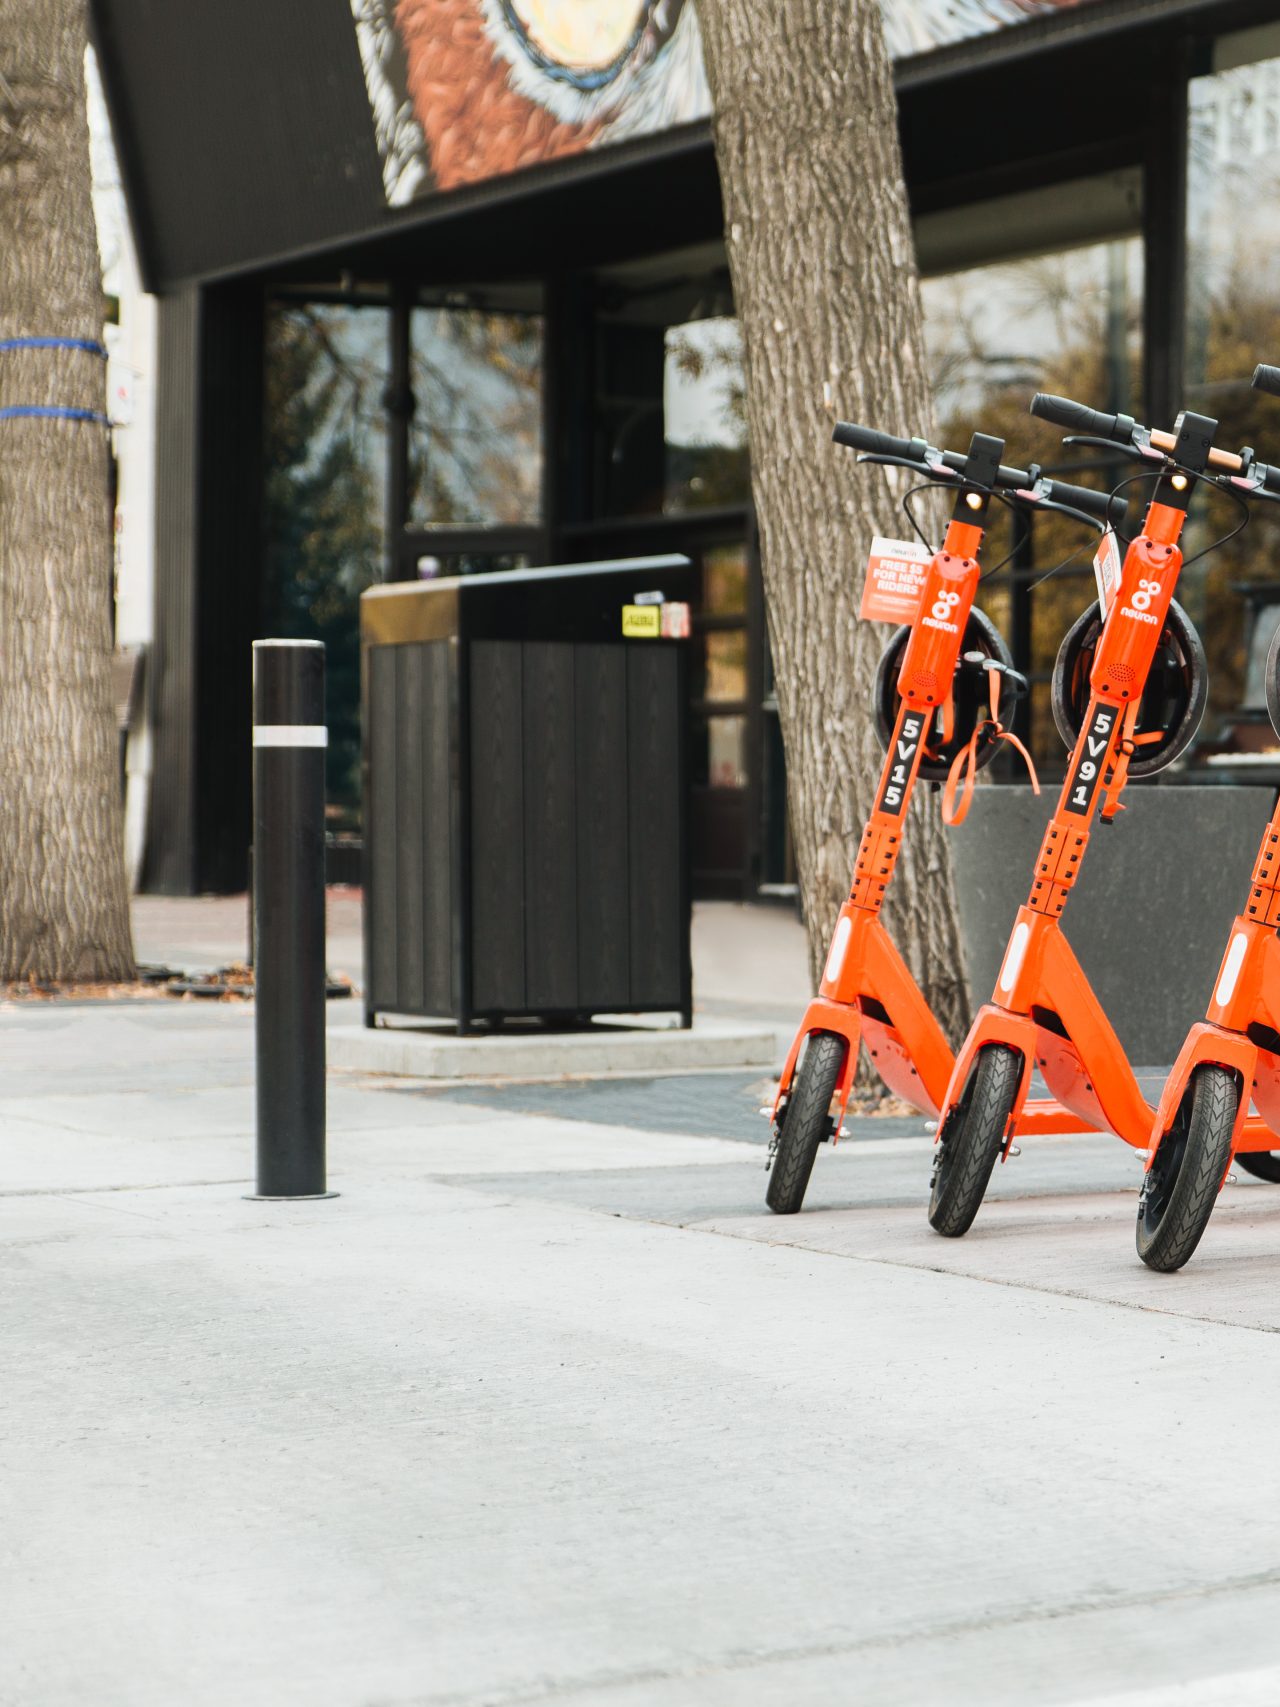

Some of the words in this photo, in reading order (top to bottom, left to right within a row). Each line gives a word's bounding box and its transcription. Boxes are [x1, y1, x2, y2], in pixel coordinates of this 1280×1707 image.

[880, 560, 909, 573] FREE
[910, 563, 924, 575] $5
[873, 569, 897, 581] FOR
[898, 573, 926, 586] NEW
[877, 580, 919, 595] RIDERS
[1120, 606, 1158, 625] neuron
[921, 616, 958, 634] neuron
[884, 718, 920, 806] 5V15
[1072, 713, 1112, 806] 5V91
